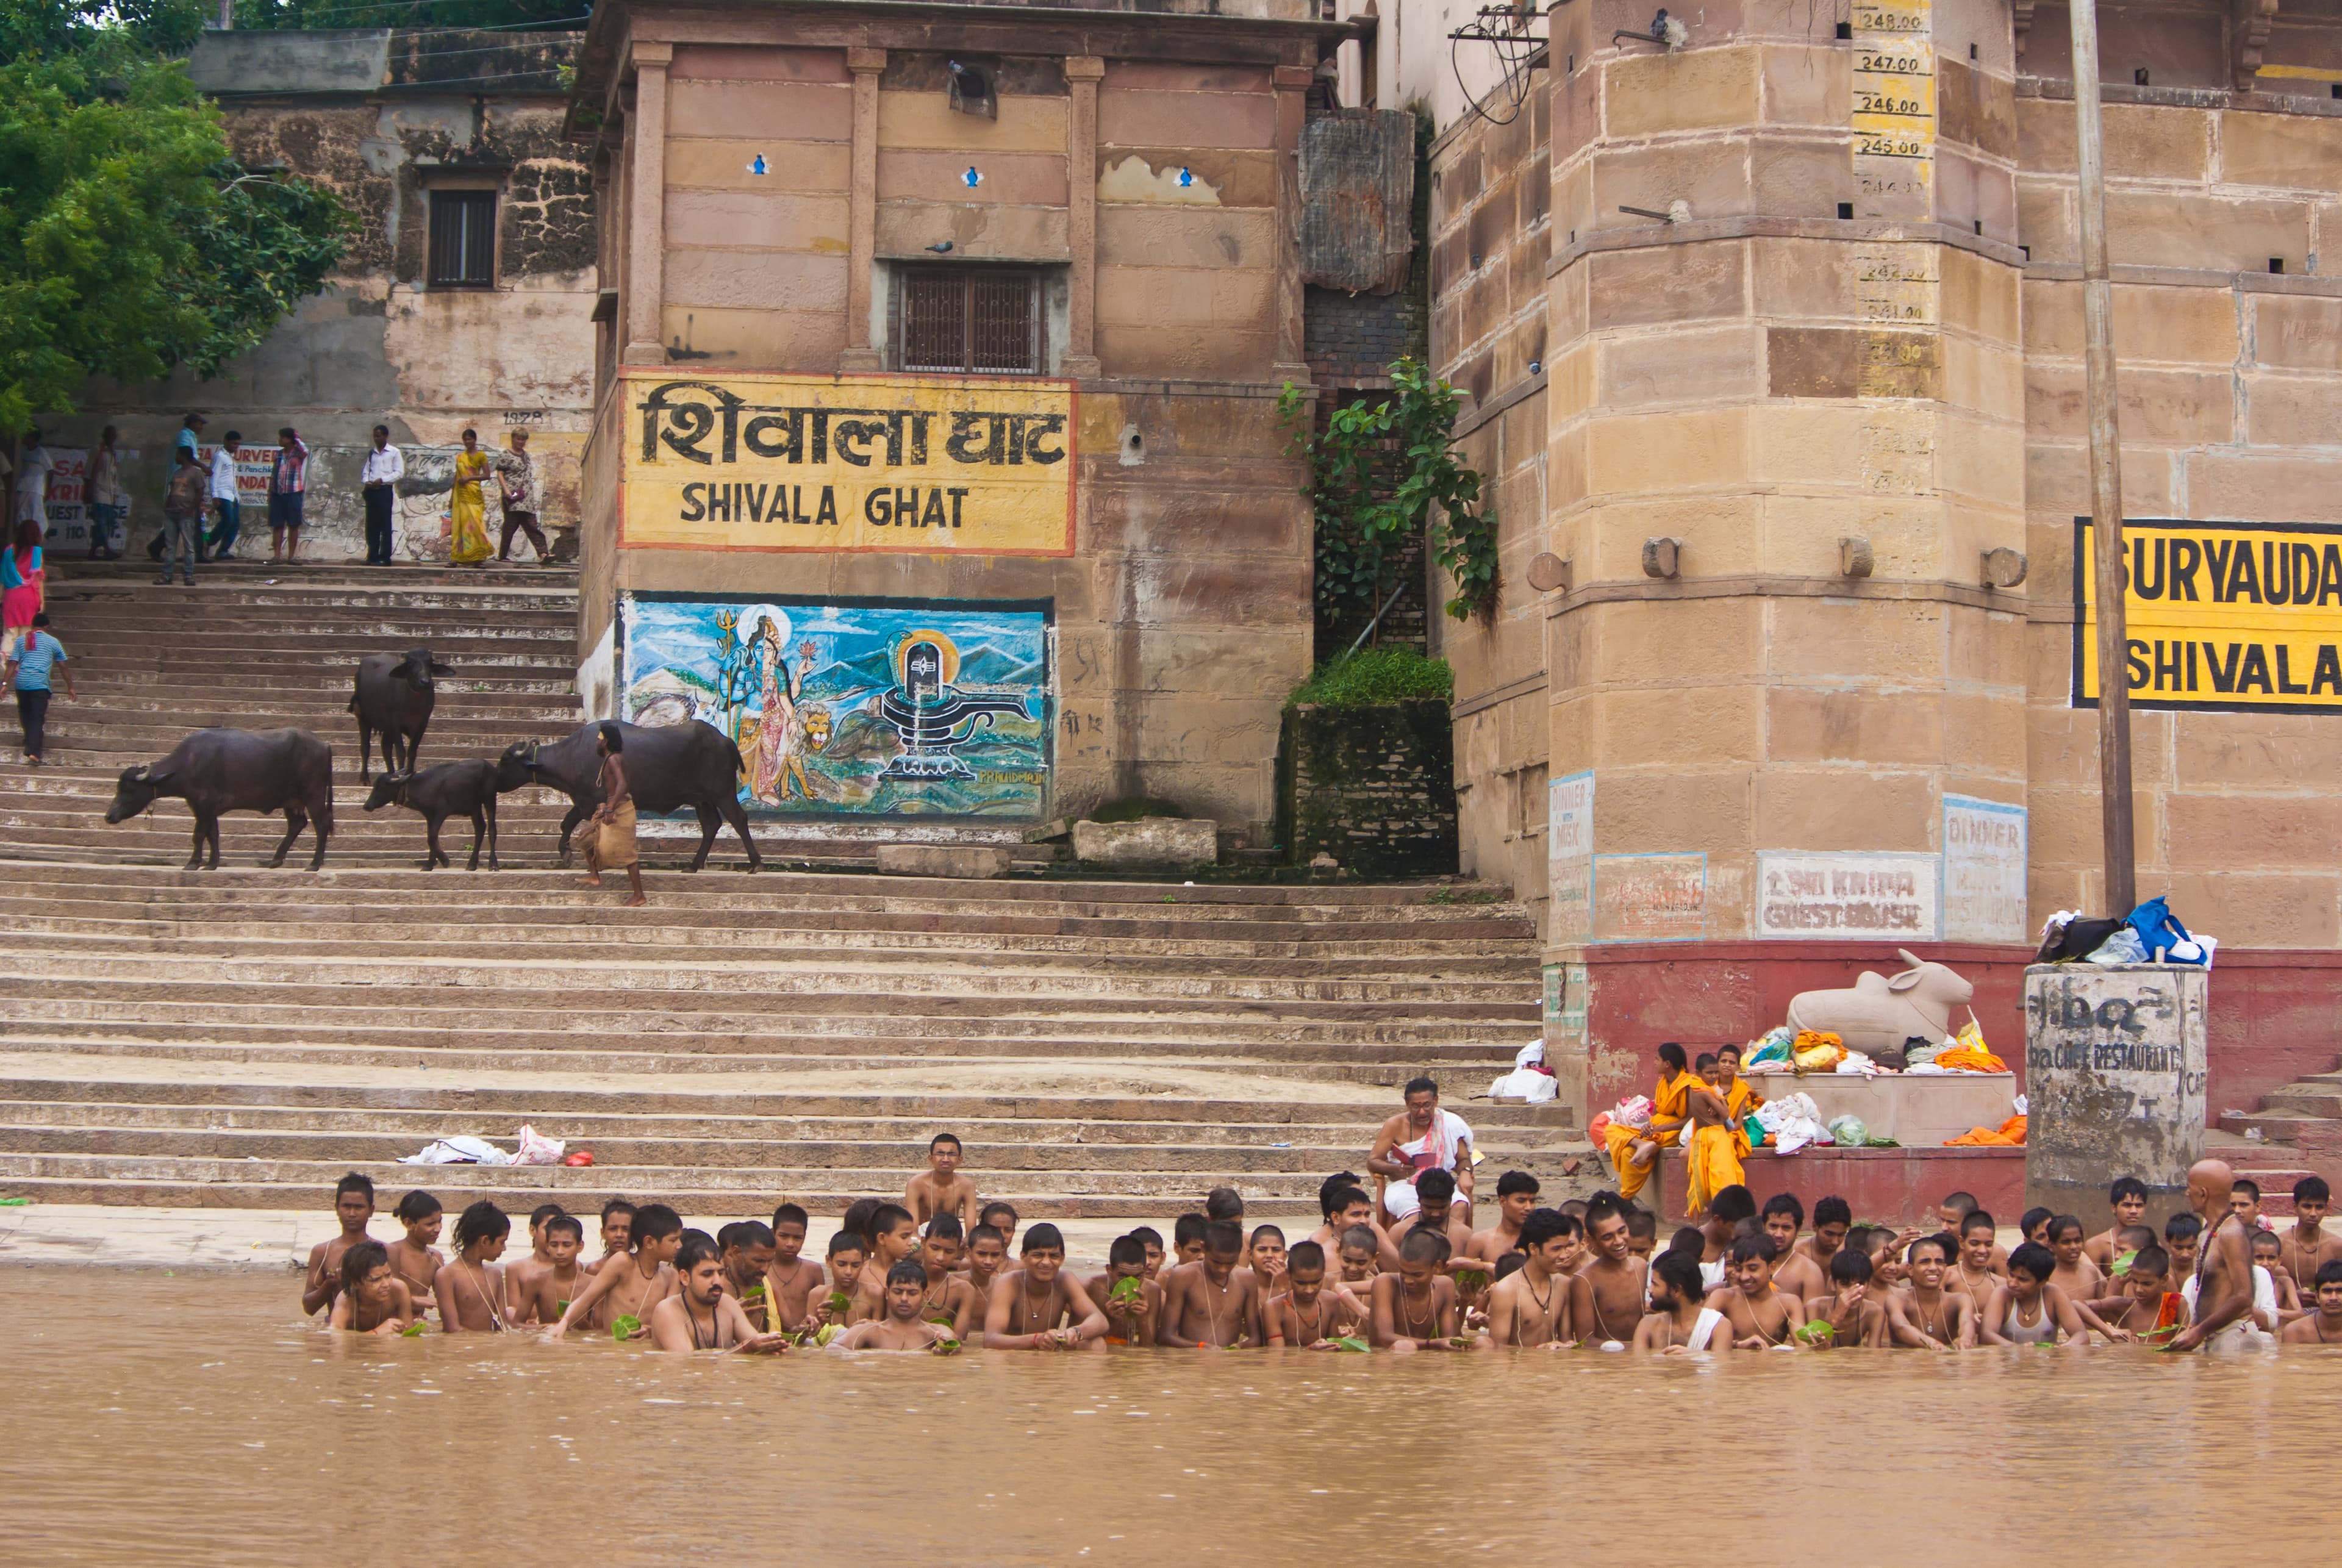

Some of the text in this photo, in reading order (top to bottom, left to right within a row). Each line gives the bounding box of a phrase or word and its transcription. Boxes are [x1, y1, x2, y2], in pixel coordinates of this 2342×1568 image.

[1863, 13, 1921, 29] 248.00
[1863, 56, 1918, 71] 247.00
[1862, 97, 1919, 113] 246.00
[1861, 139, 1918, 154] 245.00
[636, 382, 1067, 467] शिवाला घाट
[681, 482, 969, 529] SHIVALA GHAT
[2122, 537, 2342, 606] URYAUDA
[2126, 639, 2342, 696] SHIVALA
[1552, 783, 1586, 811] DINNER
[1948, 817, 2019, 849] DINNER
[2094, 1043, 2180, 1072] RESTAURANT
